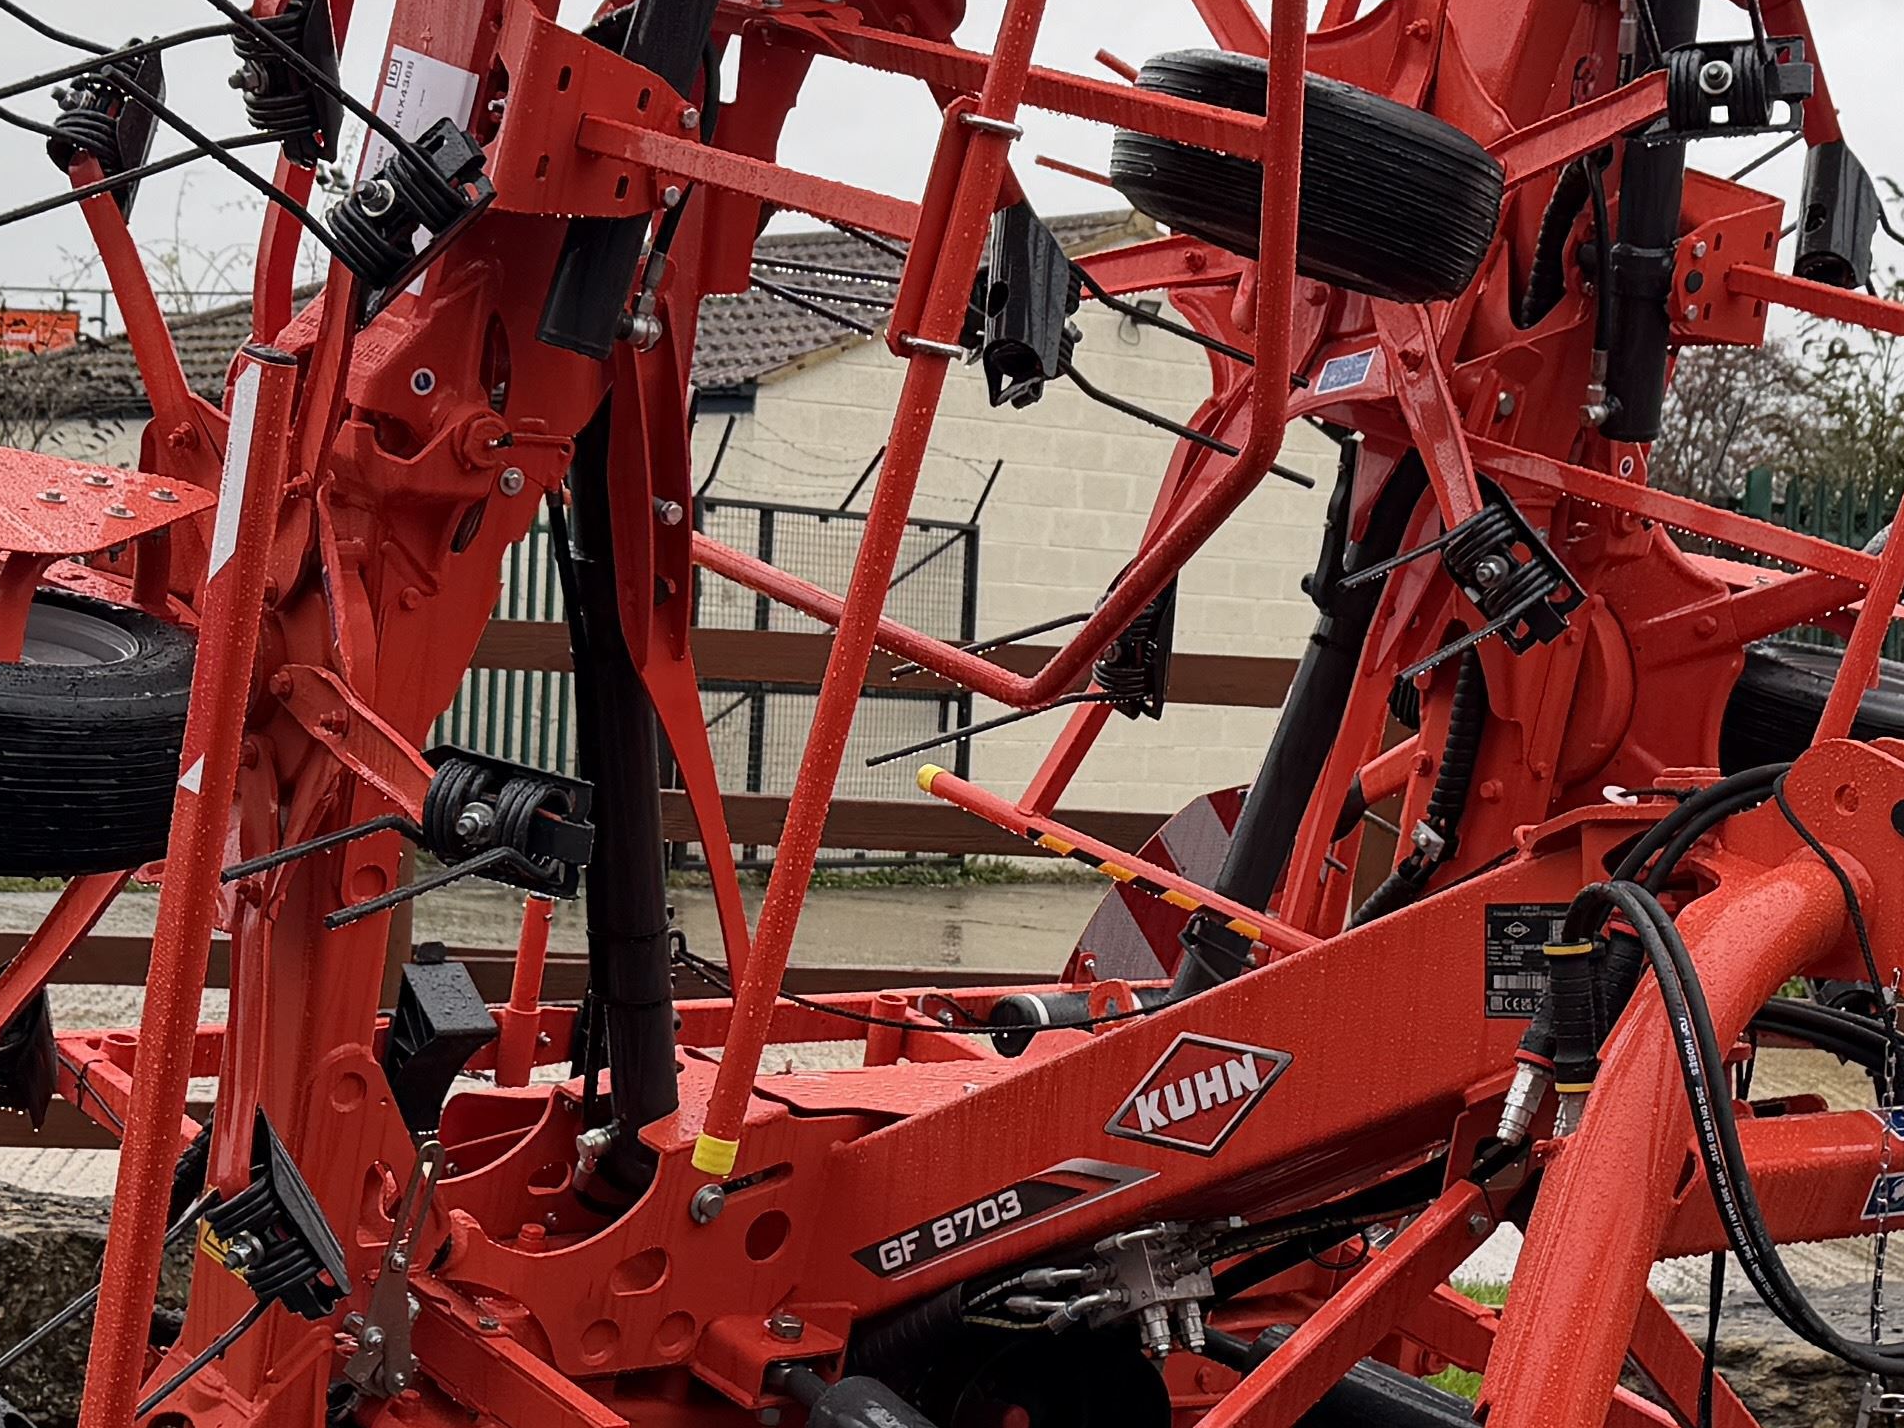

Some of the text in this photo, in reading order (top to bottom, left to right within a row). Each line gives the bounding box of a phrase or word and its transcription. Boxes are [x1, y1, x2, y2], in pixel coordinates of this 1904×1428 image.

[1134, 1052, 1260, 1133] KUHN
[878, 1189, 1022, 1271] GF 8703
